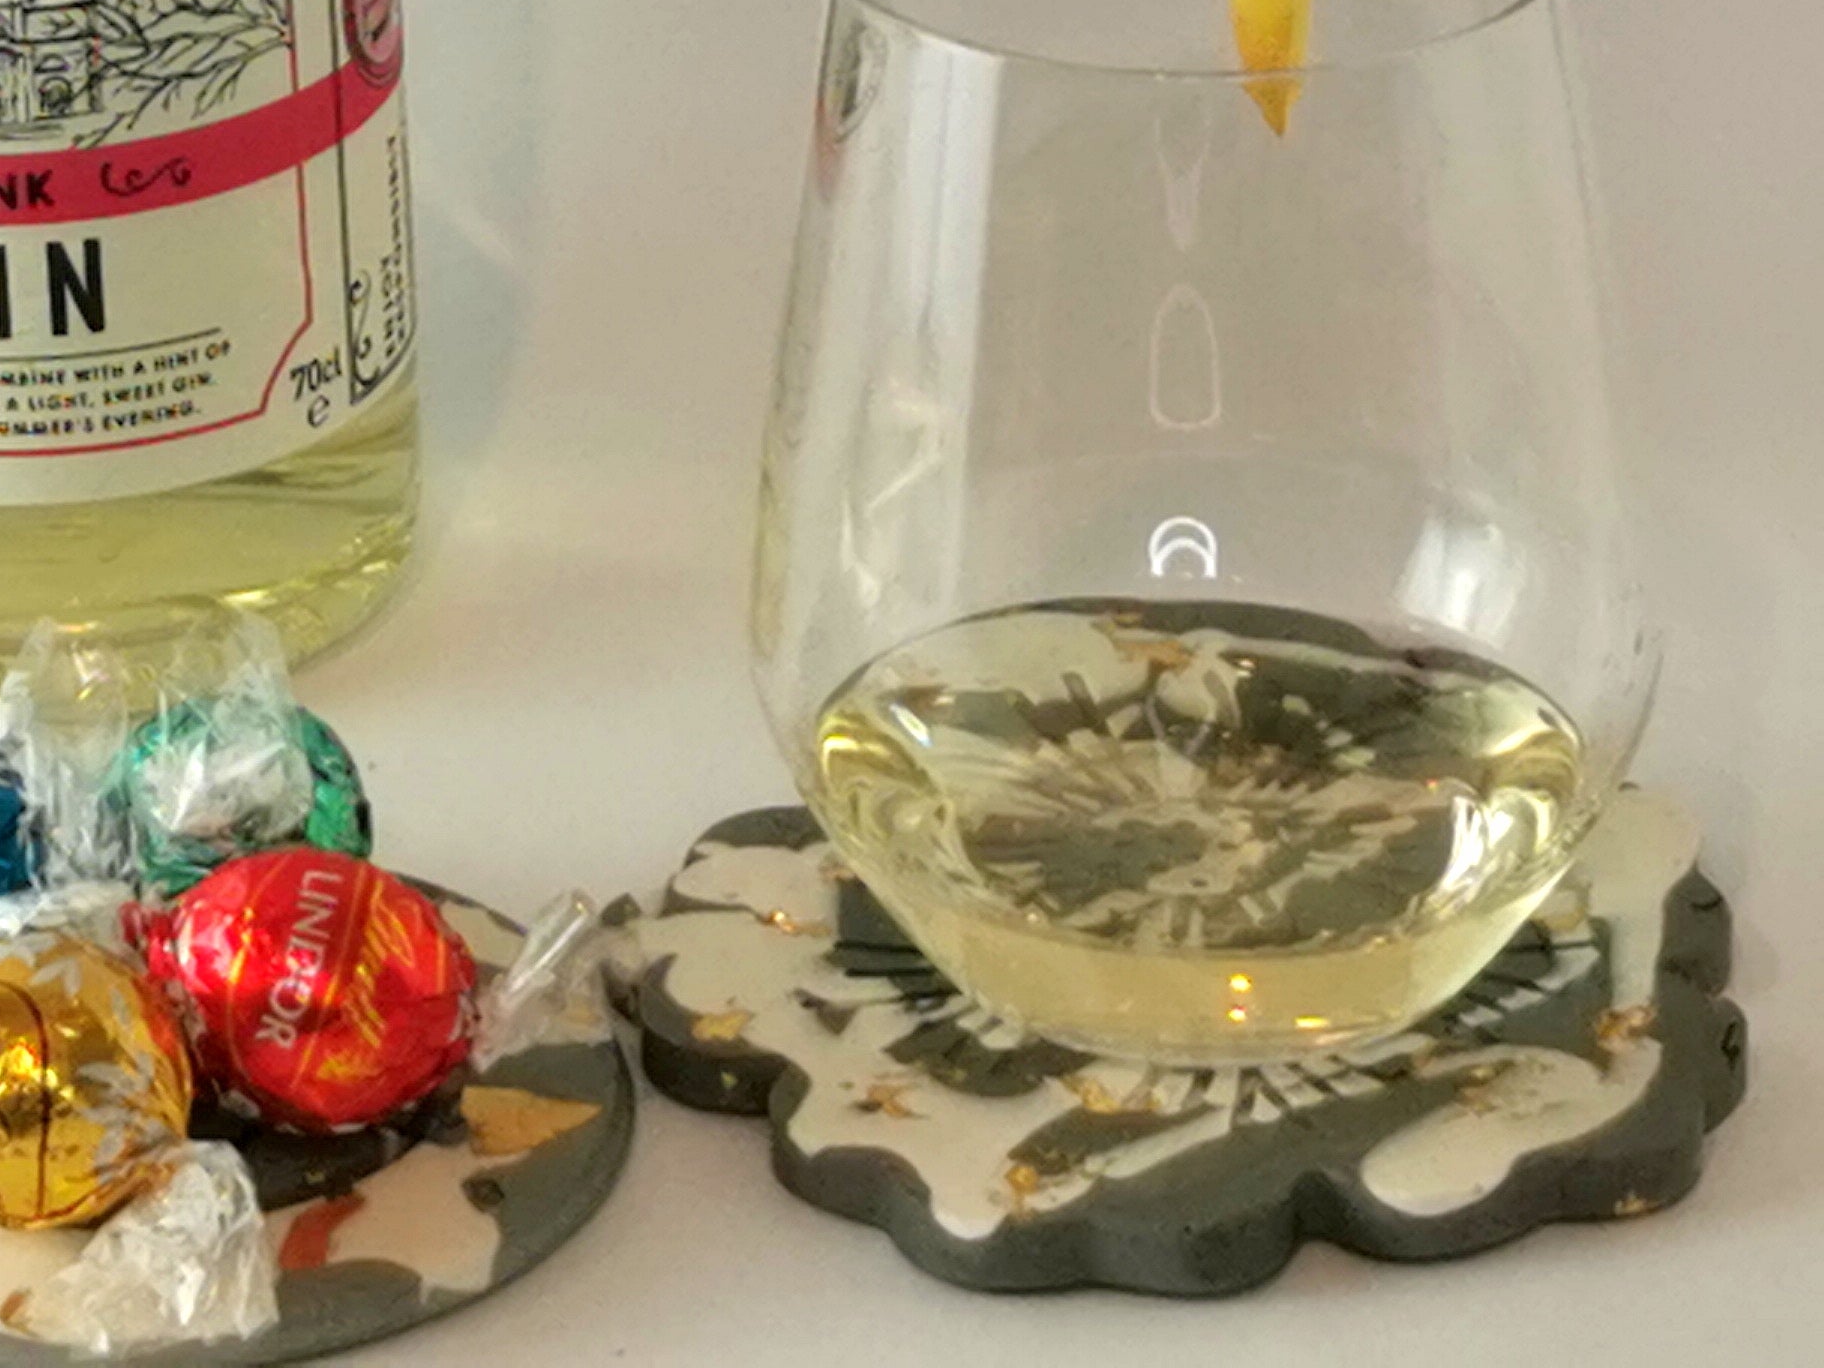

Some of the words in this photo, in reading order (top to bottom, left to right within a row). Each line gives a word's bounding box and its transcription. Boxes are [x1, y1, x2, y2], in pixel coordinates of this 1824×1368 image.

[73, 364, 125, 383] WITH
[133, 360, 146, 374] A
[153, 349, 199, 372] HINT
[205, 340, 230, 360] OF
[7, 396, 18, 410] A
[255, 869, 342, 1049] LINDOR
